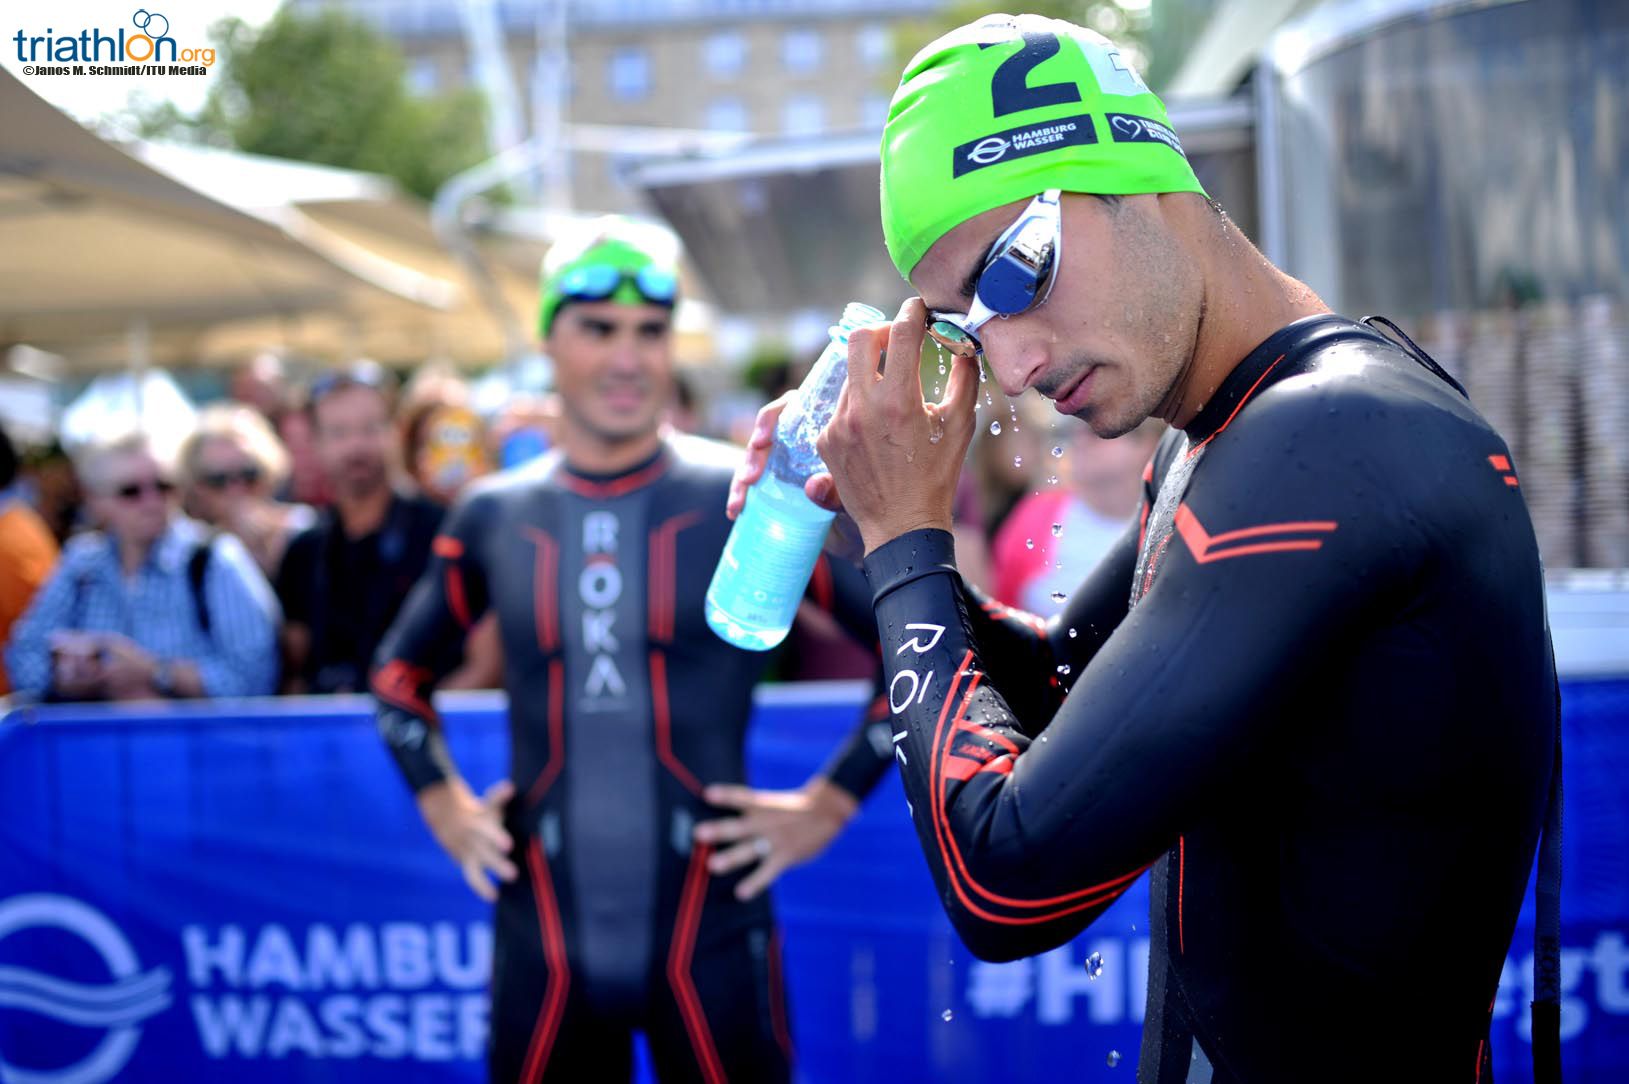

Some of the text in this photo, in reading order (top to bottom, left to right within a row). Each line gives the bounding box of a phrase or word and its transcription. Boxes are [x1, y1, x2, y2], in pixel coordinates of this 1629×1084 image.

[1012, 122, 1077, 143] HAMBURG
[1013, 133, 1065, 150] WASSER
[182, 921, 496, 989] HAMBU
